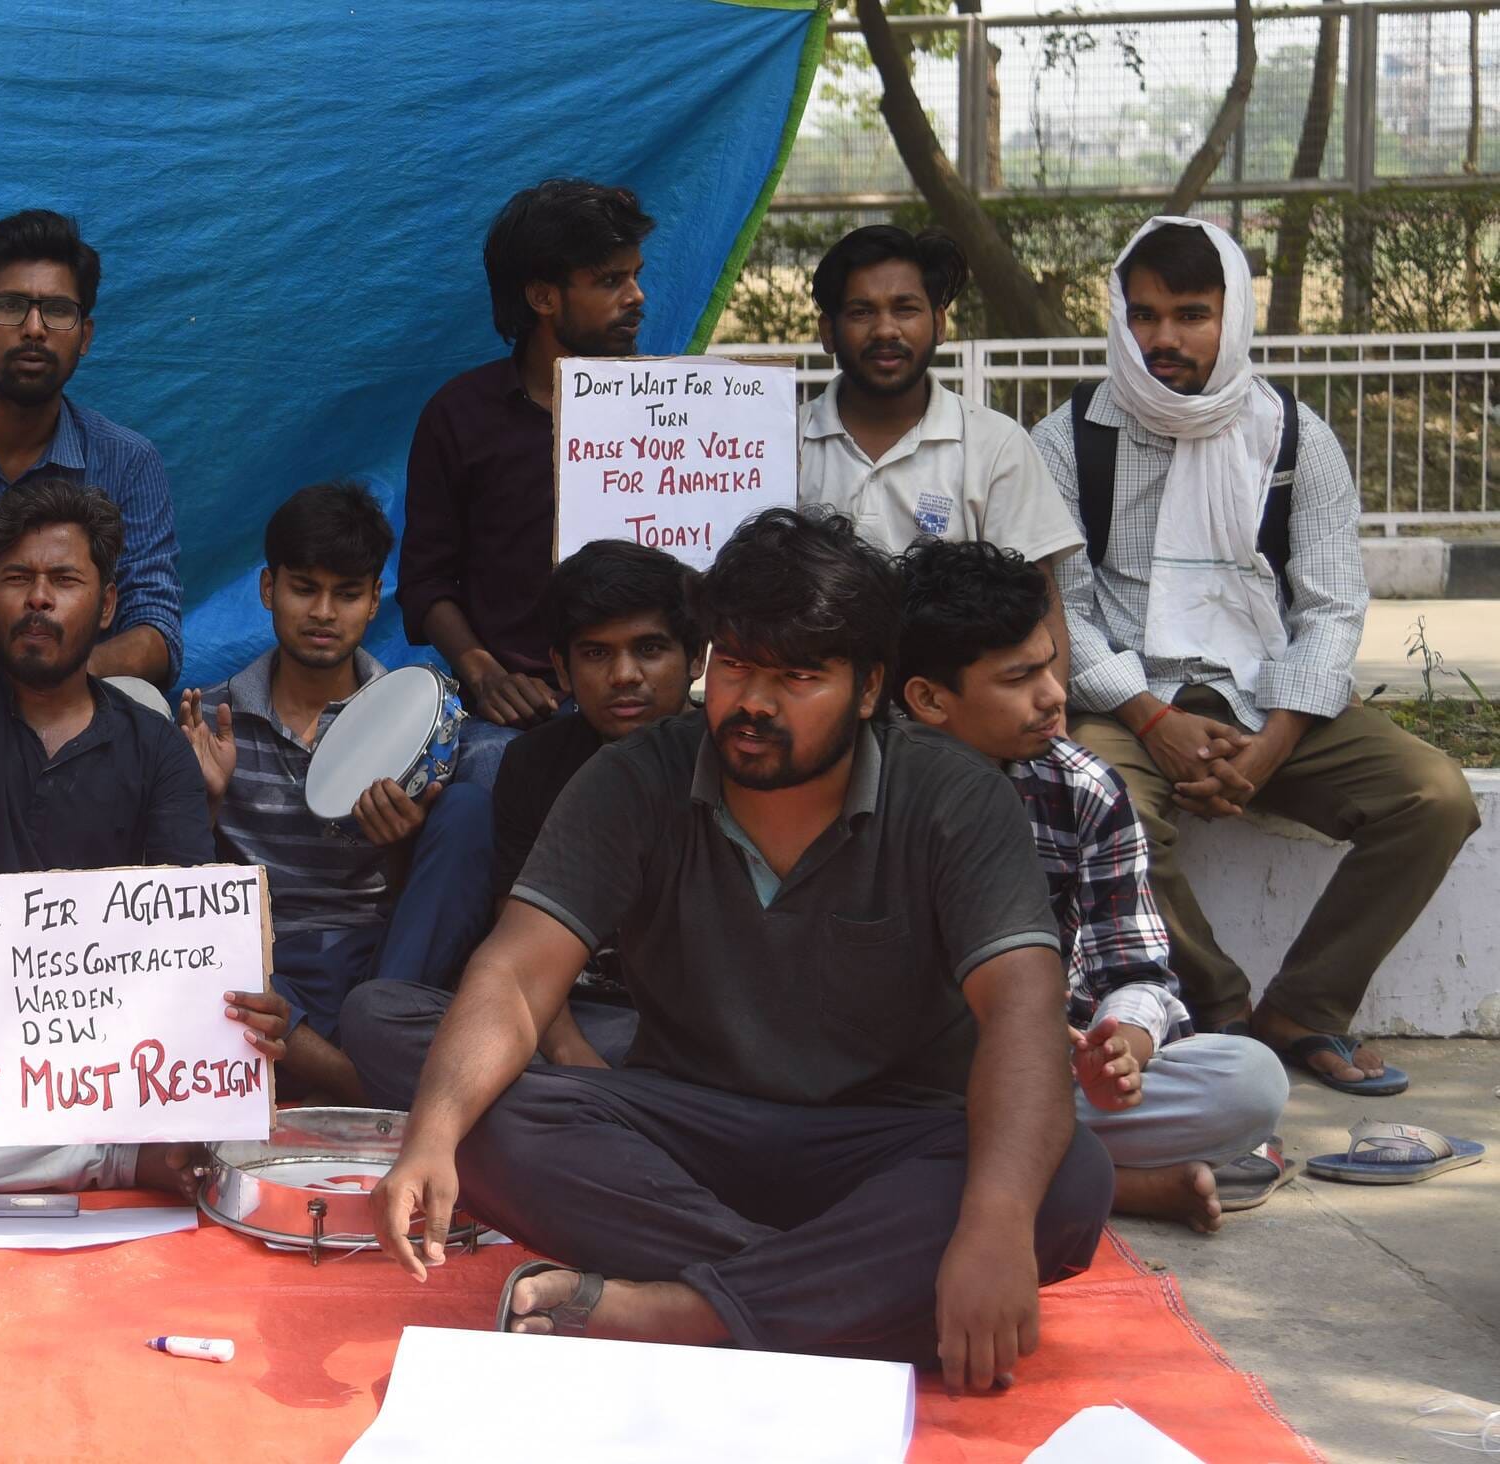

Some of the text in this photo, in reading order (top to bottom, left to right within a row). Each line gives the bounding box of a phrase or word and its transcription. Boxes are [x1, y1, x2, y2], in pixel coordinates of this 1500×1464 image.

[631, 371, 677, 396] WAIT
[684, 373, 712, 396] FOR
[724, 376, 764, 396] YOUR
[645, 403, 688, 427] TURN
[568, 432, 764, 462] RAISE YOUR VOICE
[603, 466, 761, 495] FOR ANAMIKA
[625, 514, 711, 551] TODAY!
[24, 888, 79, 931] FIR
[102, 878, 257, 926] AGAINST
[15, 985, 123, 1014] WARDEN,
[22, 1016, 107, 1046] DSW,
[20, 1055, 120, 1112] MUST
[130, 1038, 262, 1108] RESIGN
